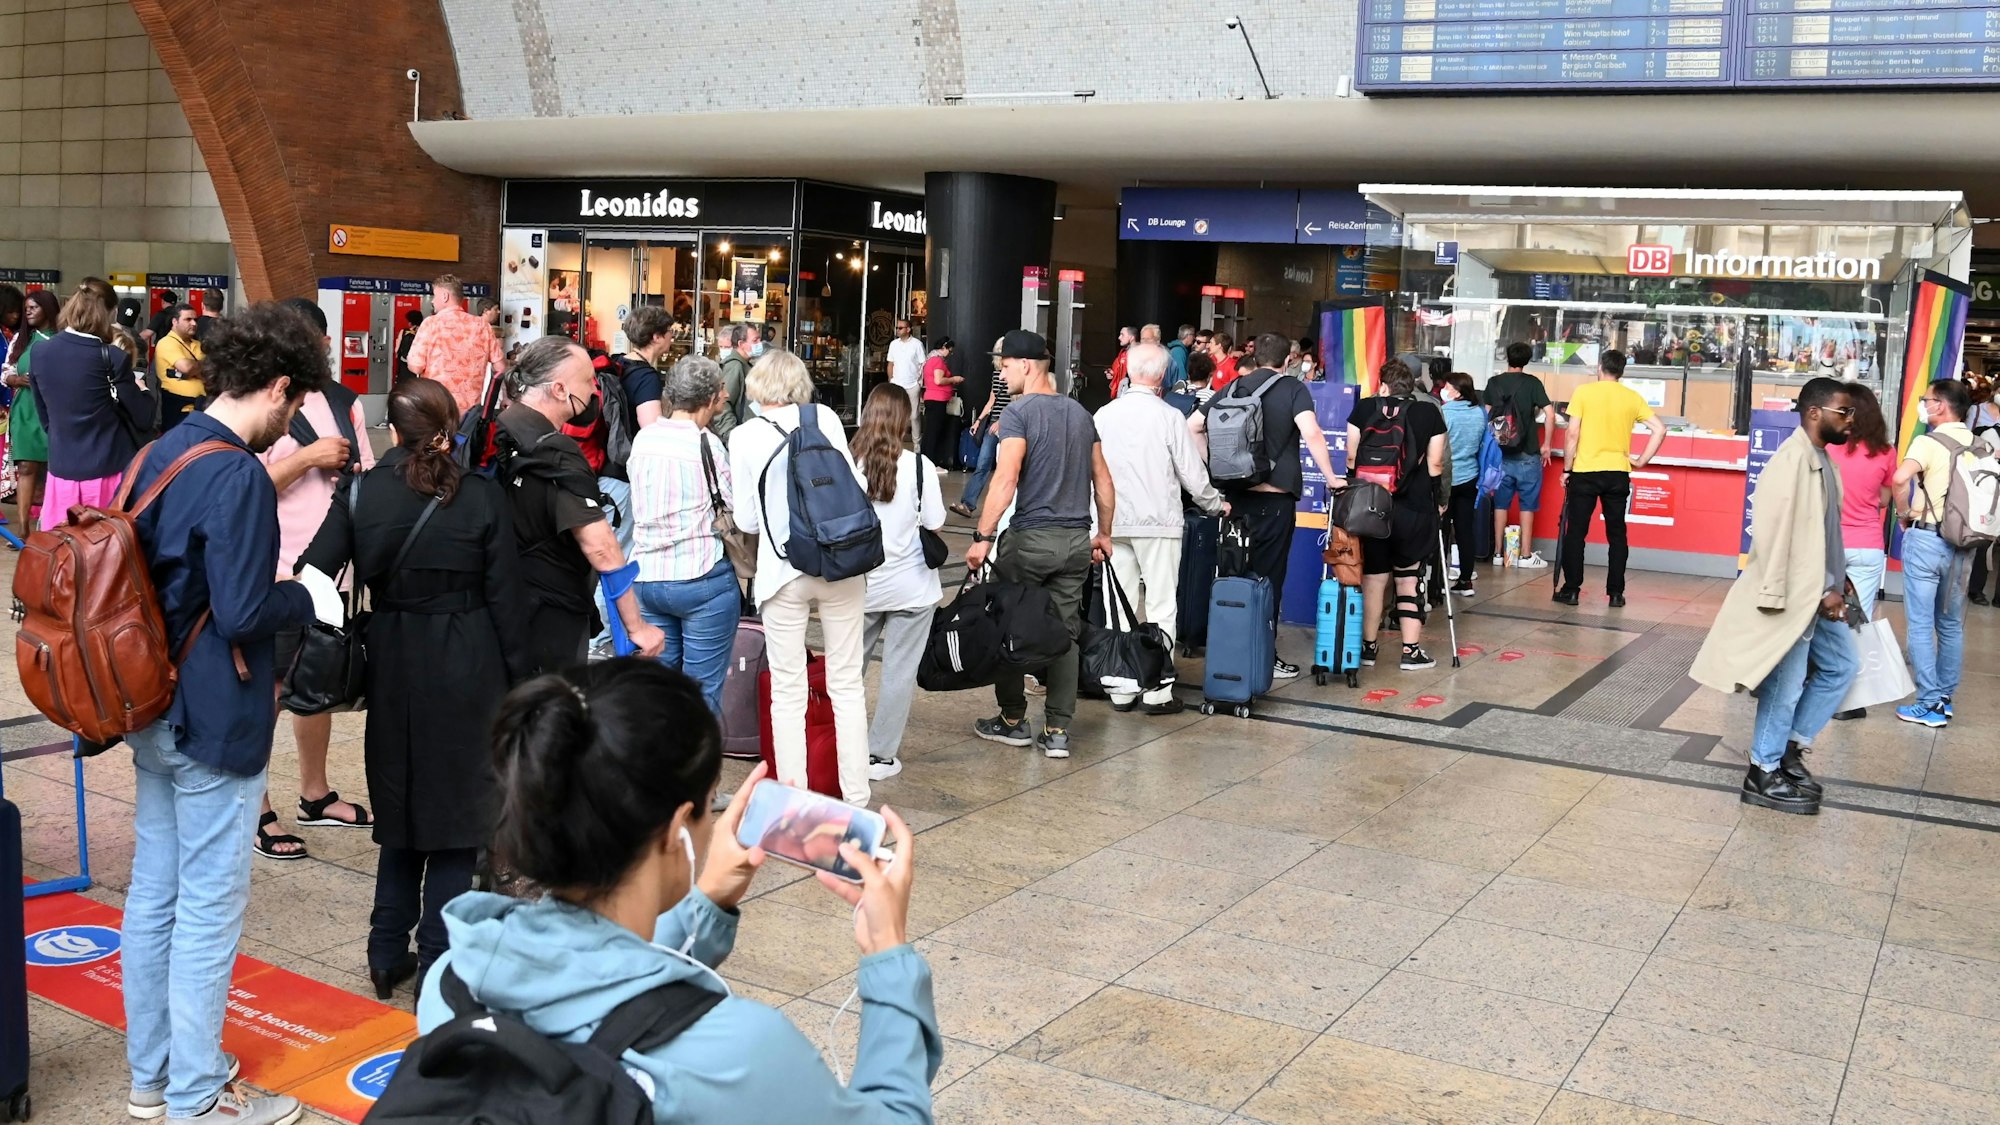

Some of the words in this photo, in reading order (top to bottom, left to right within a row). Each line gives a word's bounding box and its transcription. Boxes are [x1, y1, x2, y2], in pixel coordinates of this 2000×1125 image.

[580, 188, 700, 219] Leonidas
[1148, 218, 1158, 226] DB
[1160, 218, 1186, 228] Lounge
[1328, 221, 1381, 230] ReiseZentrum
[1632, 250, 1667, 269] DB
[1685, 247, 1880, 280] Information
[229, 988, 258, 999] zur
[258, 1012, 337, 1044] beachten!
